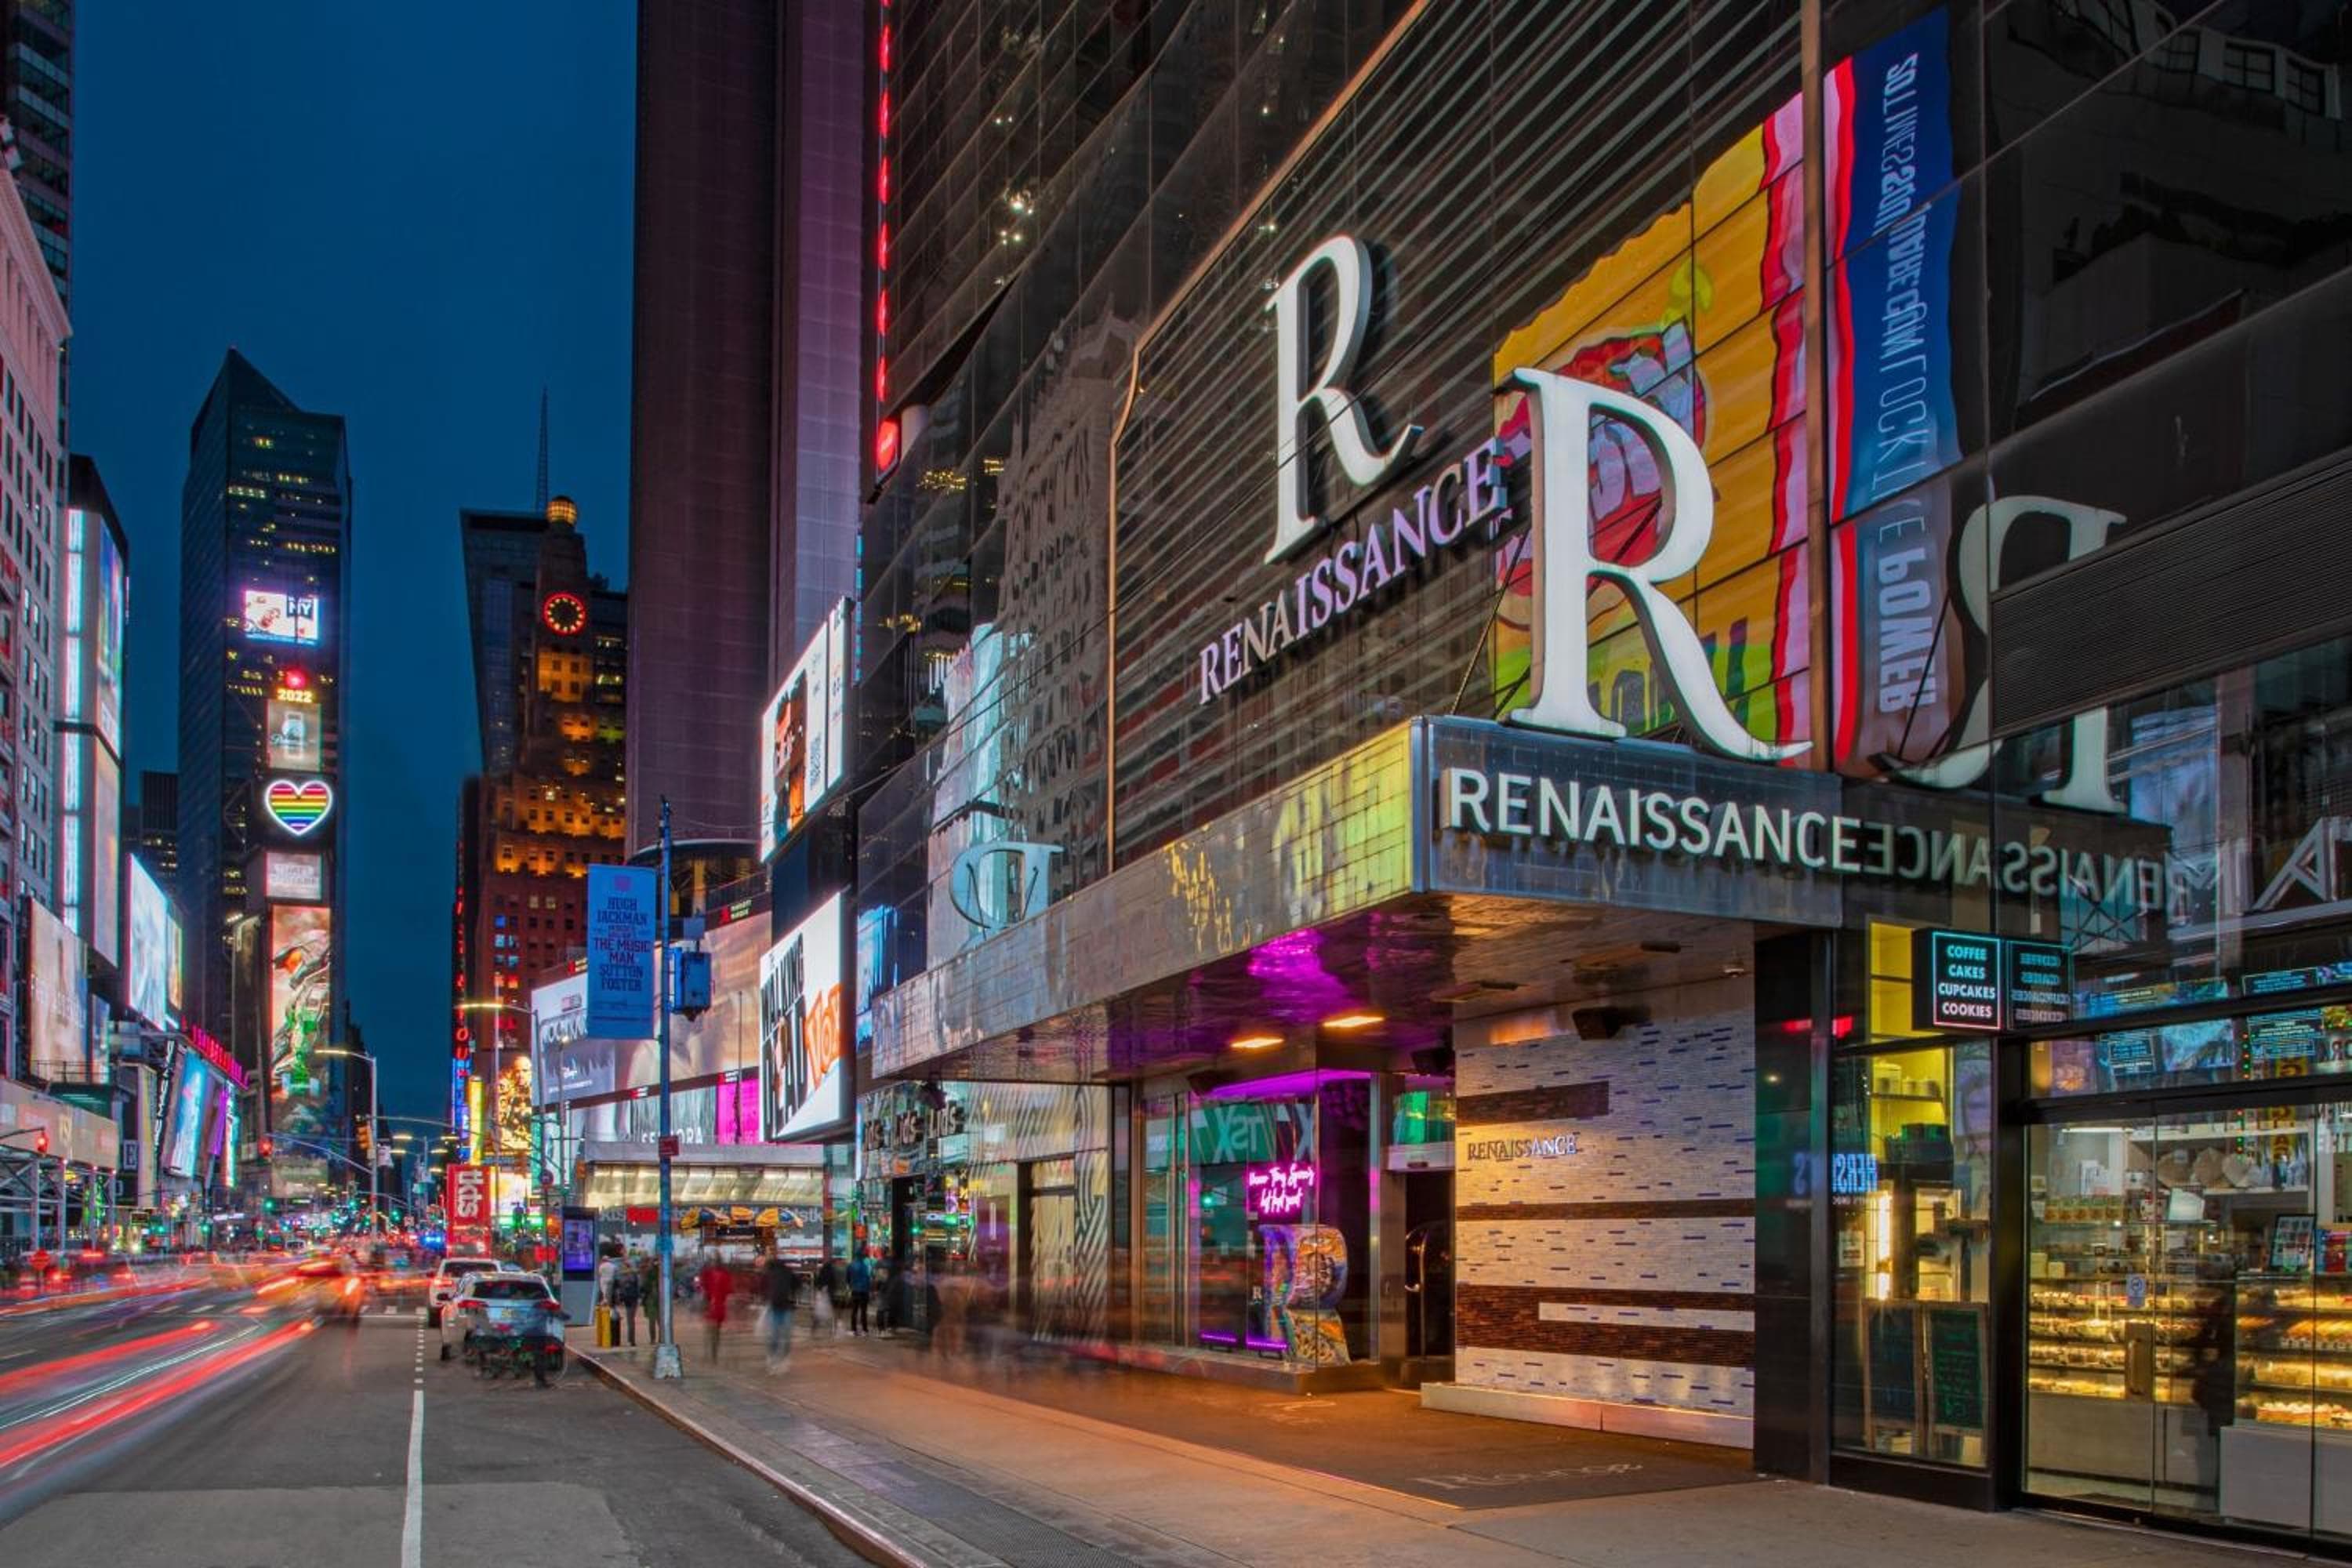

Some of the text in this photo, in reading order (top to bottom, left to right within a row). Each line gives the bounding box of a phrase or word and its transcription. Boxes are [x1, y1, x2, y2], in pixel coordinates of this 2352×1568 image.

[1265, 234, 1423, 566] R
[1199, 439, 1512, 704] RENAISSANCE
[1512, 368, 1813, 764] R
[277, 688, 313, 702] 2022
[1446, 768, 1862, 873] RENAISSANCE
[597, 909, 648, 924] JACKMAN
[593, 938, 651, 952] THE MUSIC
[1947, 945, 1987, 960] COFFEE
[609, 952, 634, 964] MAN
[600, 964, 644, 978] SUTTON
[1948, 964, 1985, 979] CAKES
[602, 978, 641, 991] FOSTER
[1938, 982, 1995, 999] CUPCAKES
[1942, 1002, 1992, 1018] COOKIES
[641, 1125, 703, 1145] SEORA
[1468, 1134, 1578, 1161] RENAISSANCE
[457, 1170, 483, 1218] tkts
